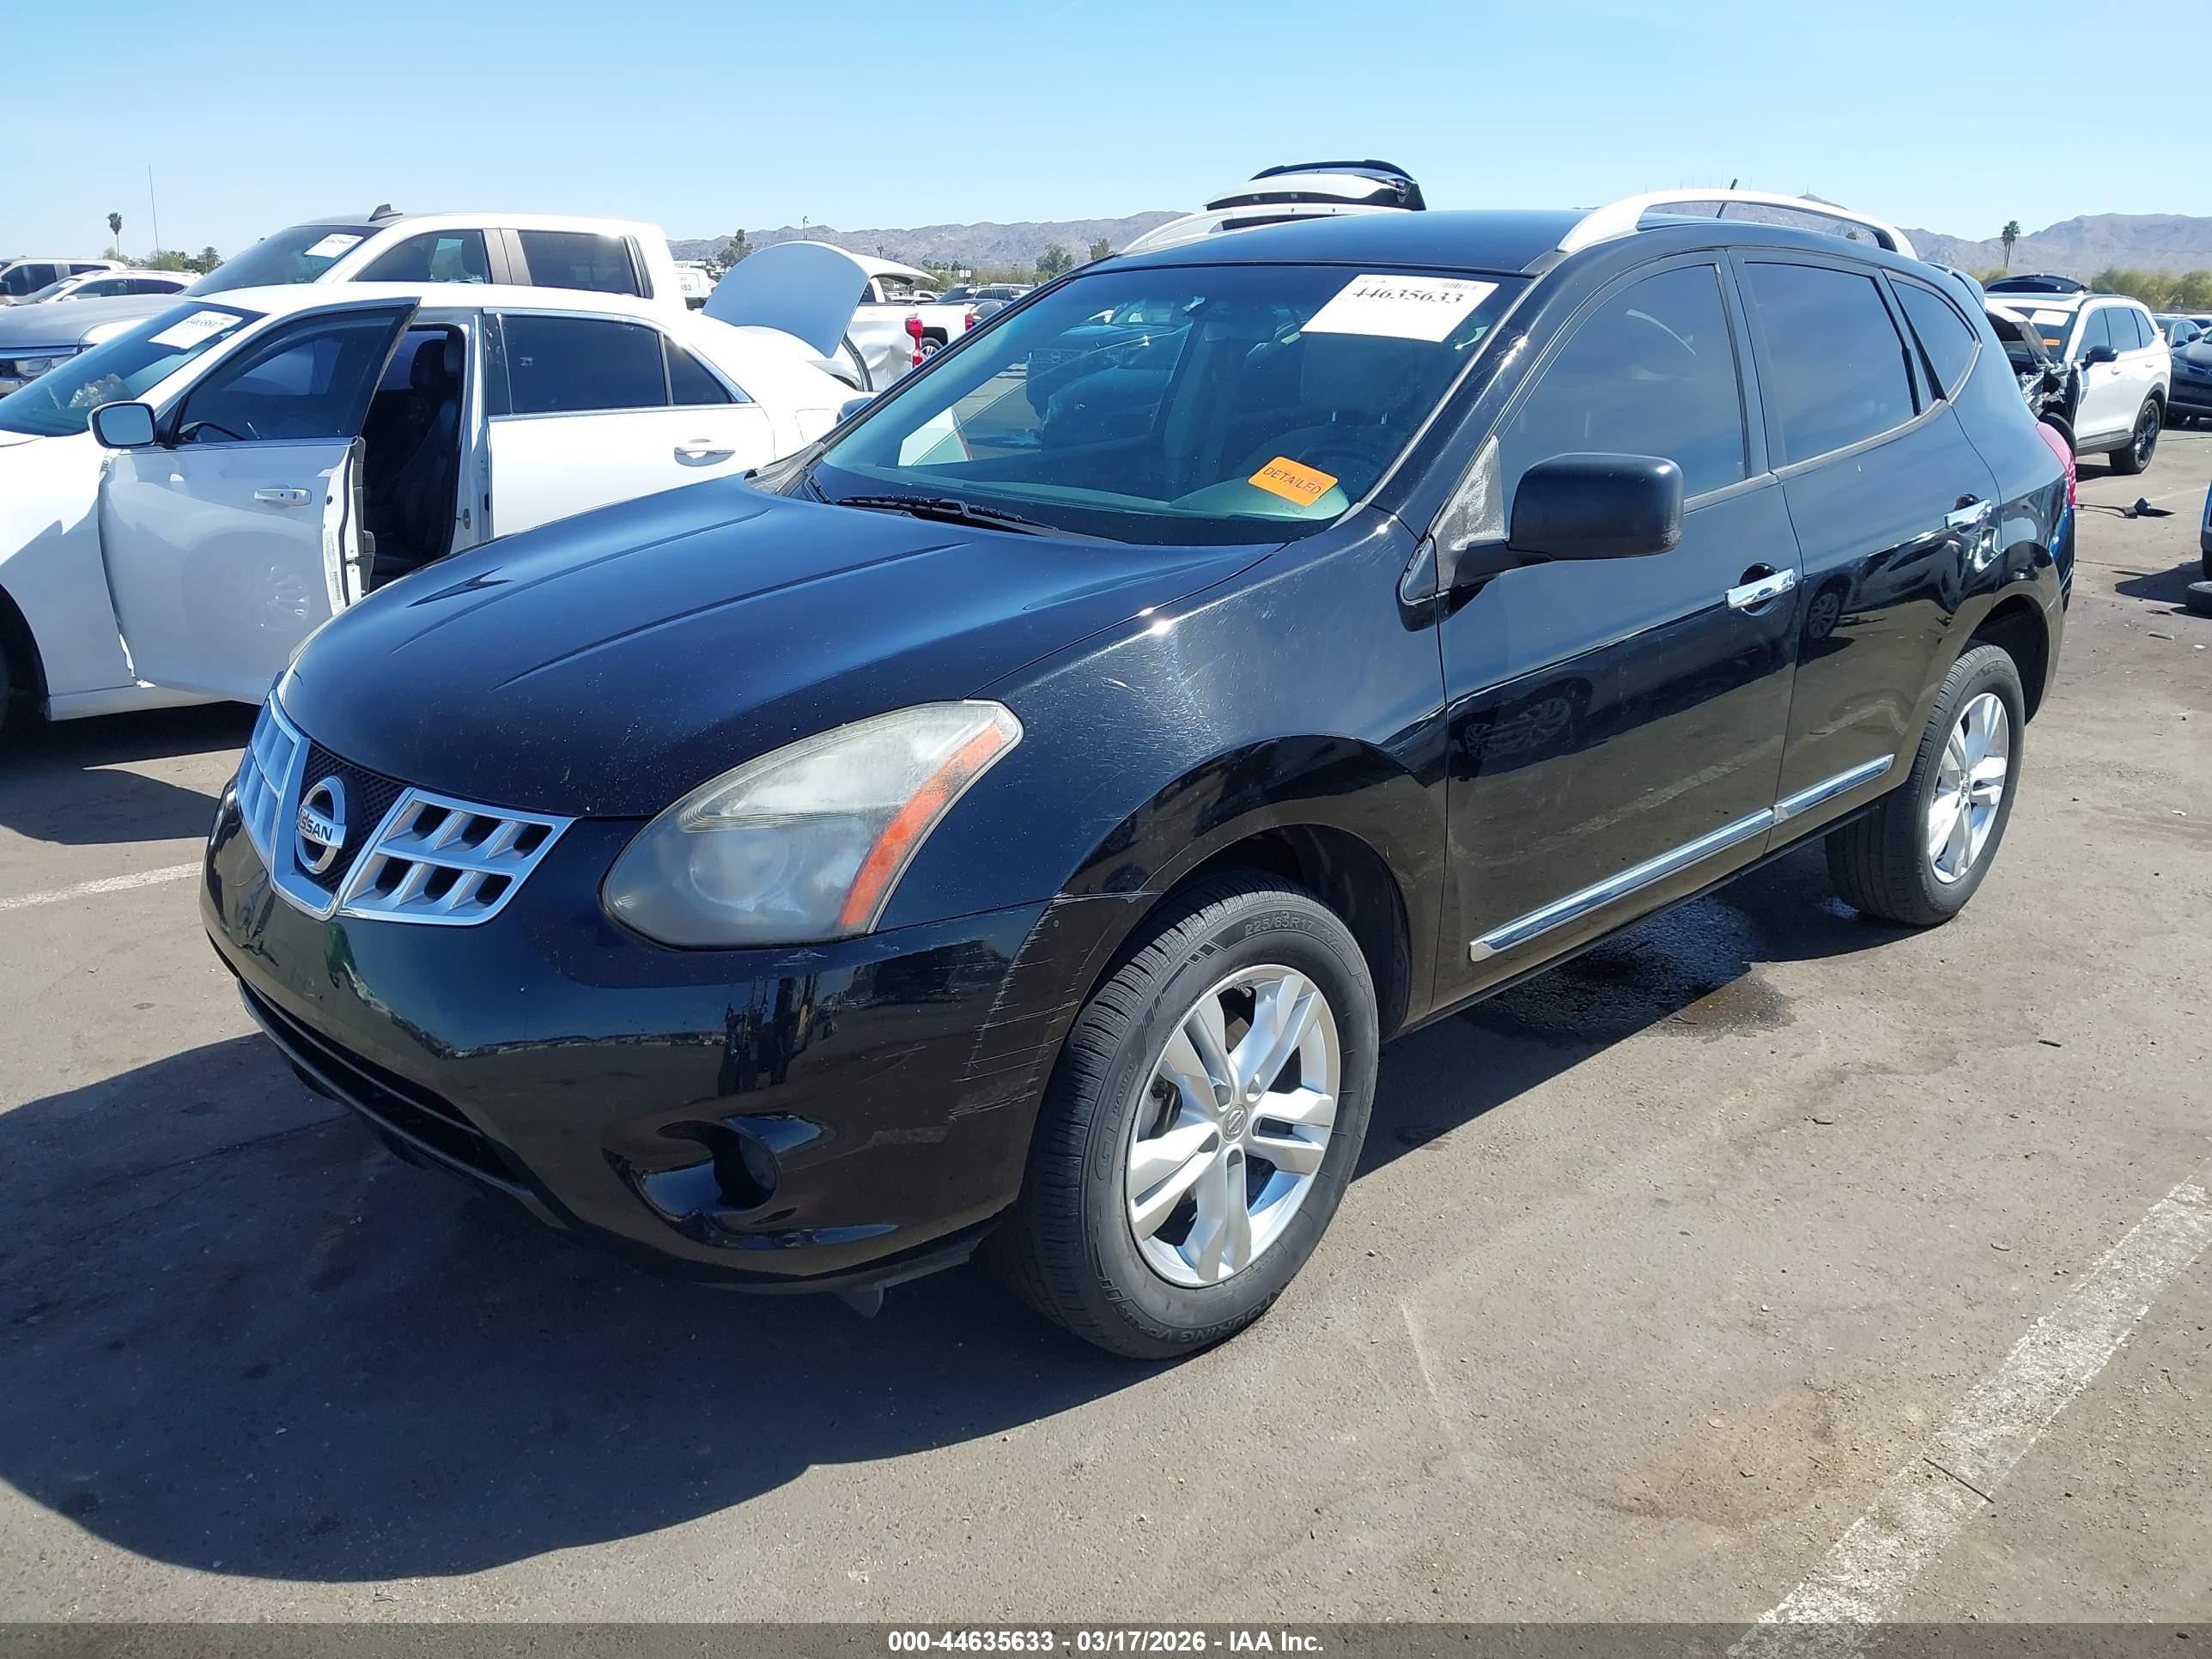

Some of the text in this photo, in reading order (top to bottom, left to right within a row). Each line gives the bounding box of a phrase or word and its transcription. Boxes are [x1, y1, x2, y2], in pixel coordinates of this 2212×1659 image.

[1352, 287, 1463, 304] 44635633
[1262, 466, 1322, 495] DETAILED
[1244, 915, 1314, 937] 225/65R17
